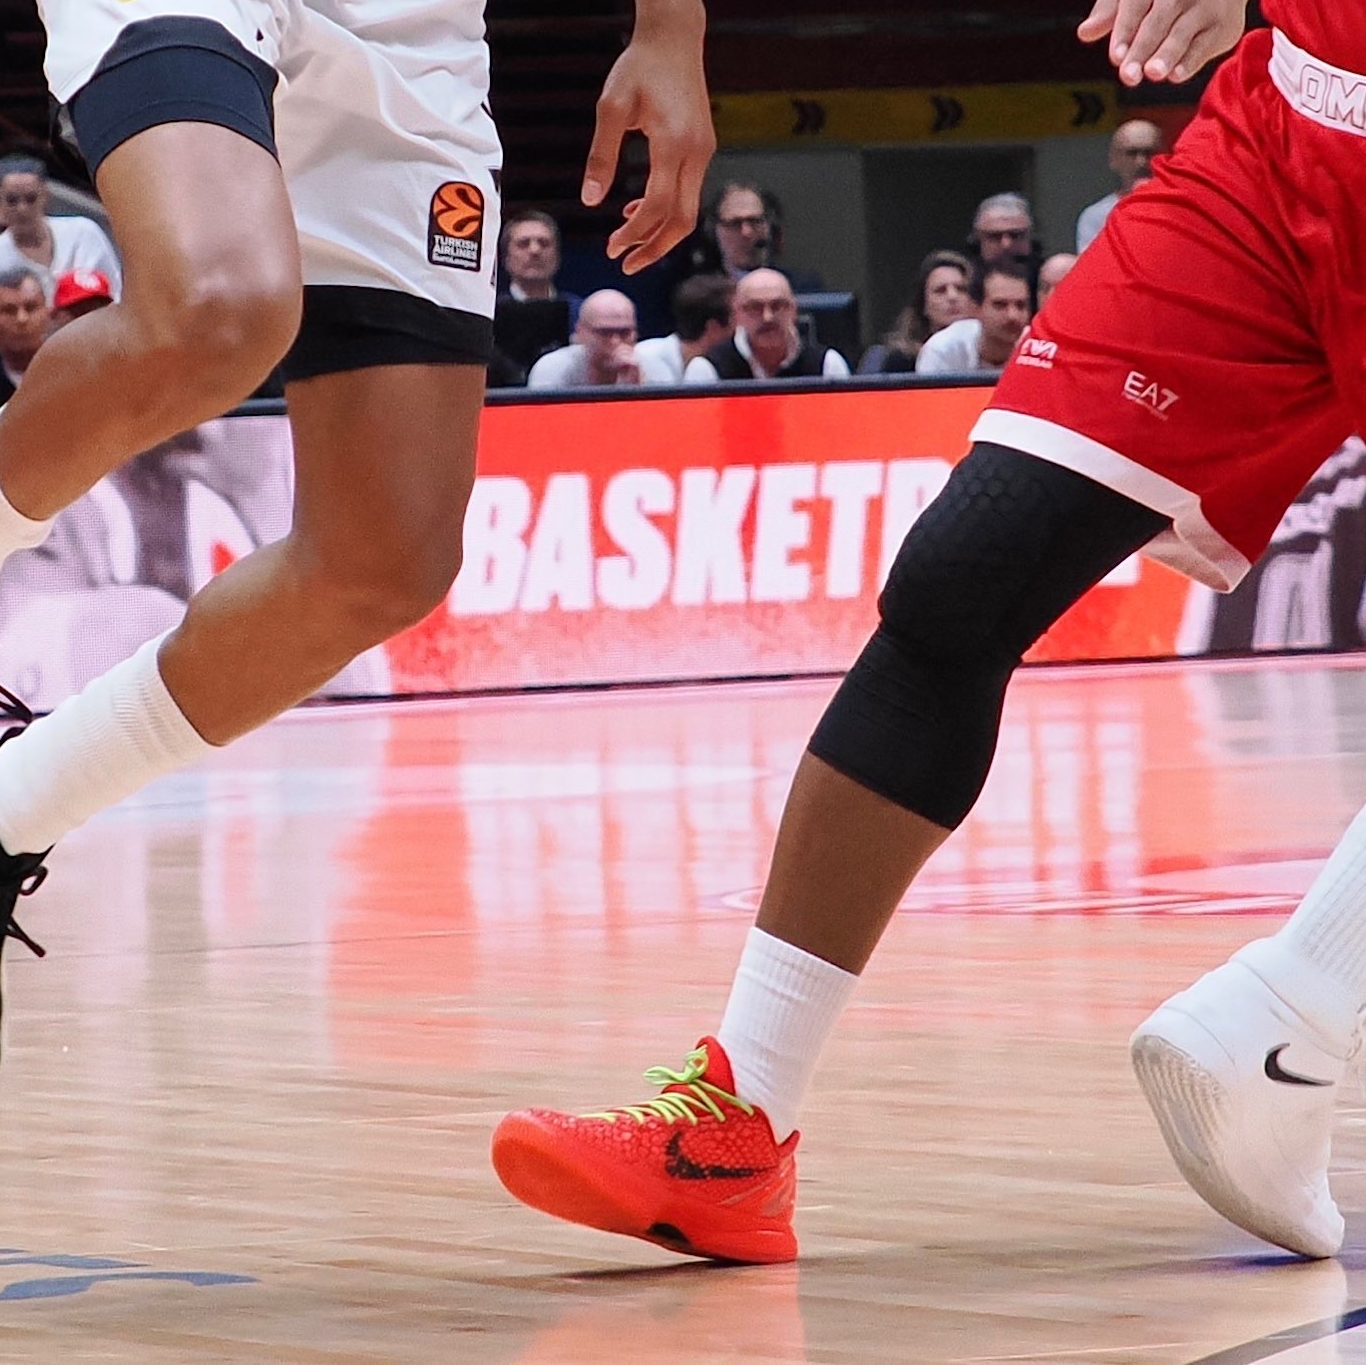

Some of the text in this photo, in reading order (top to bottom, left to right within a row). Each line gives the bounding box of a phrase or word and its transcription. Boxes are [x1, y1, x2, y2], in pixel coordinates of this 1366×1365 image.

[434, 235, 478, 251] TURKISH
[433, 245, 478, 260] AIRLINES
[1124, 370, 1179, 411] EA7
